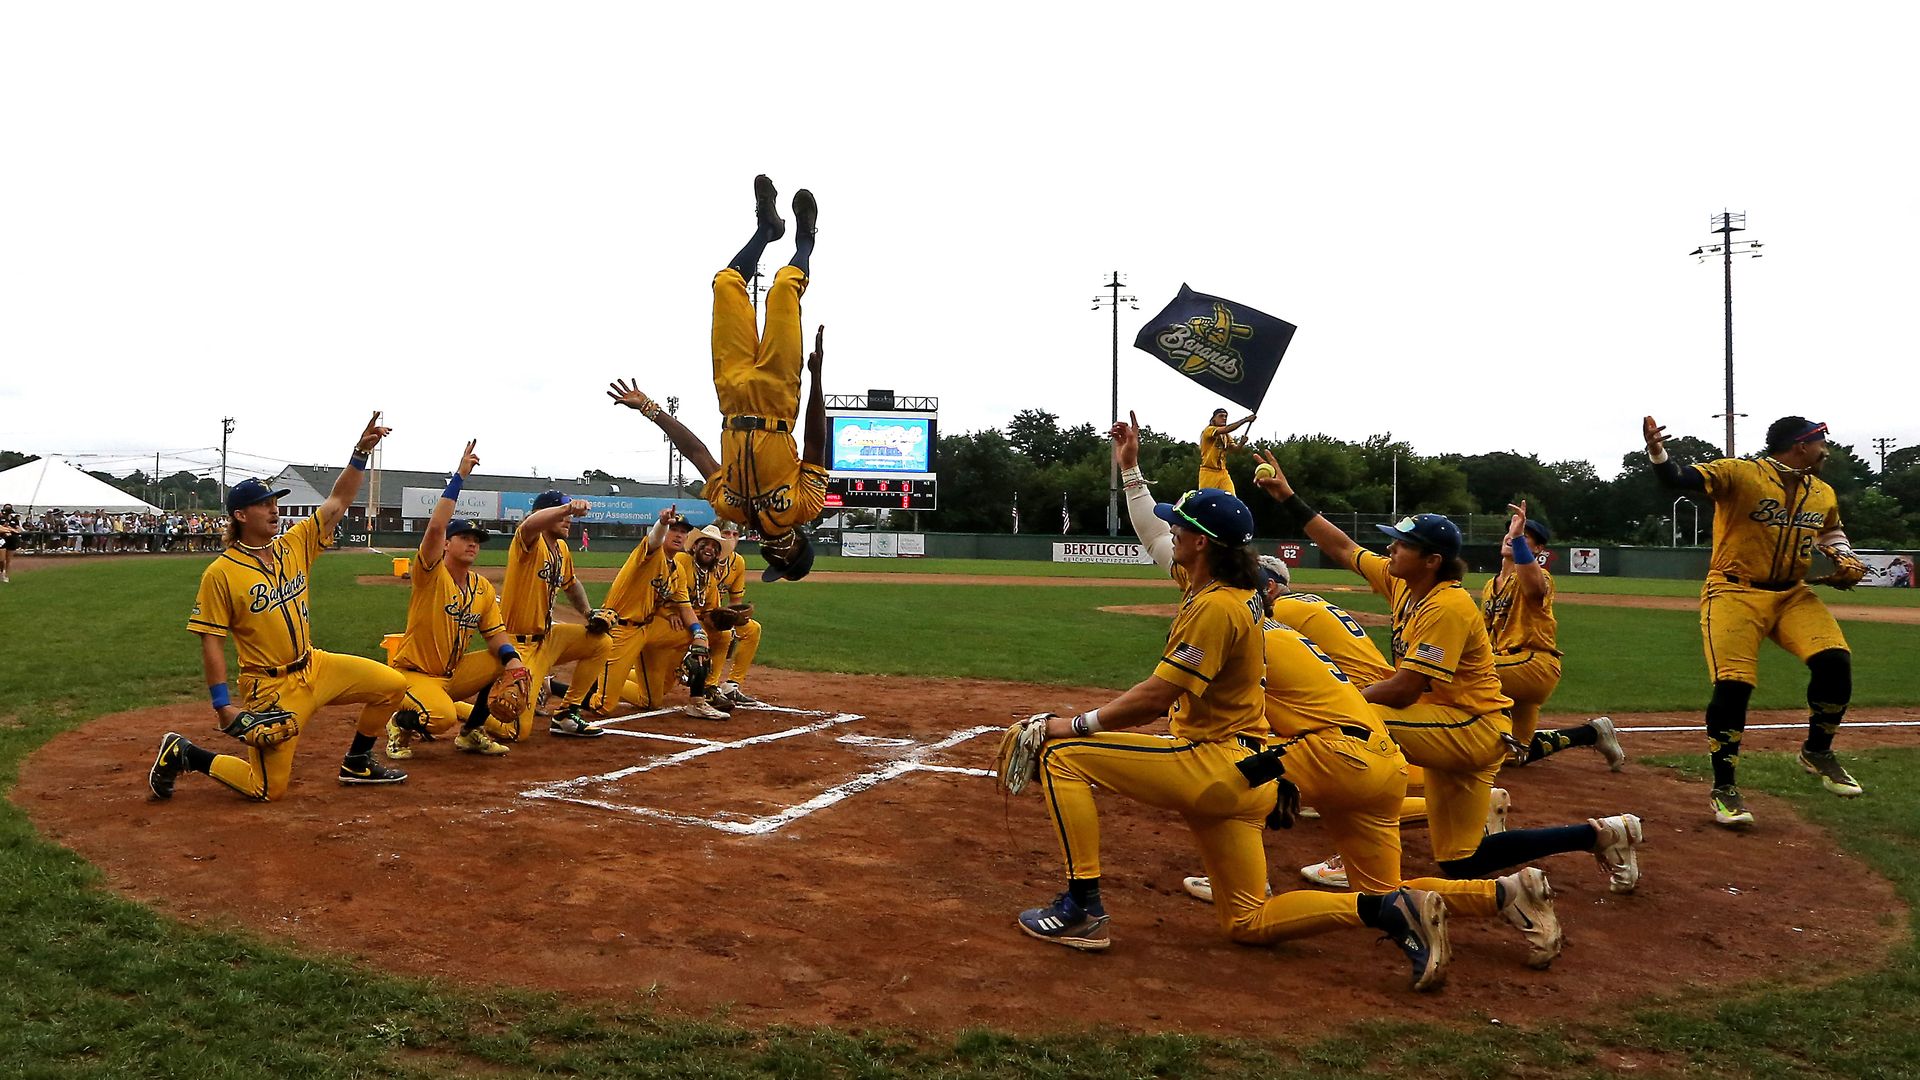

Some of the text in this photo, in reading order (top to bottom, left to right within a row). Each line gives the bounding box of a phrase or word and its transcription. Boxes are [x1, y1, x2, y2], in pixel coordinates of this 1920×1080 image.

[1159, 323, 1238, 379] Bananas
[421, 494, 465, 506] Colia
[606, 511, 652, 520] Assessment
[349, 534, 367, 543] 320
[1063, 543, 1139, 557] BERTUCCI'S
[1283, 549, 1297, 559] 62
[1325, 604, 1367, 638] 6
[1297, 637, 1350, 684] 5
